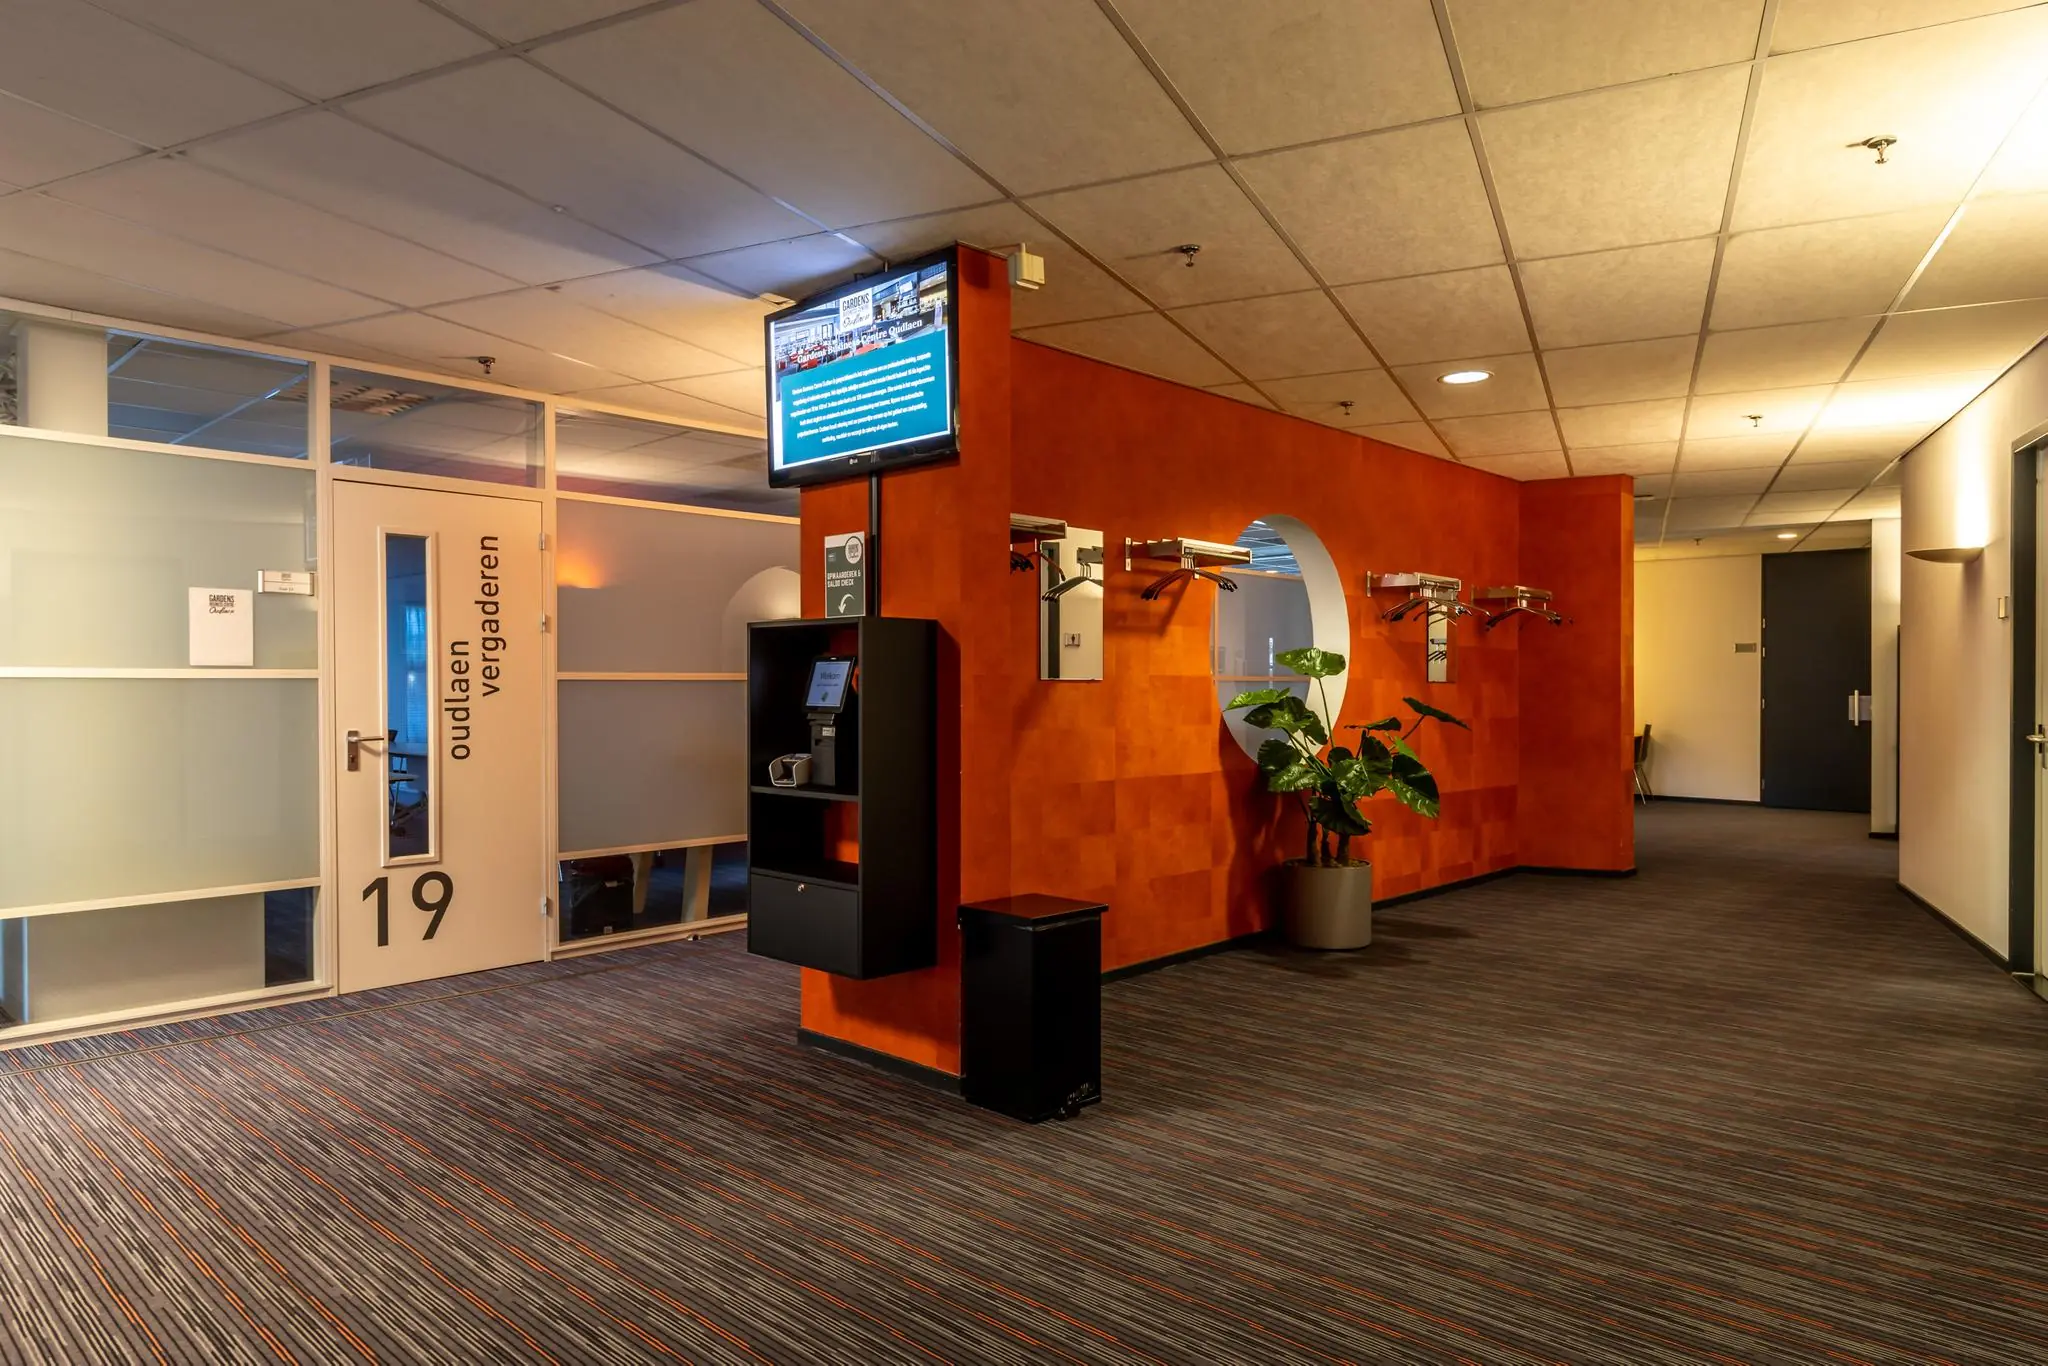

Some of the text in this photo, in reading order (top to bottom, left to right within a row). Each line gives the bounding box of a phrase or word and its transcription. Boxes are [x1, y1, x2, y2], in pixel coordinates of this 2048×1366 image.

[842, 292, 870, 312] GARDENS
[797, 348, 826, 363] Gardens
[828, 337, 860, 354] Business
[861, 330, 887, 345] Centre
[827, 571, 857, 580] OPWAARDEREN
[827, 578, 854, 588] SALDO CHECK
[209, 594, 235, 602] GARDENS
[474, 535, 506, 697] vergaderen
[444, 640, 471, 760] oudlaen
[362, 870, 454, 948] 19
